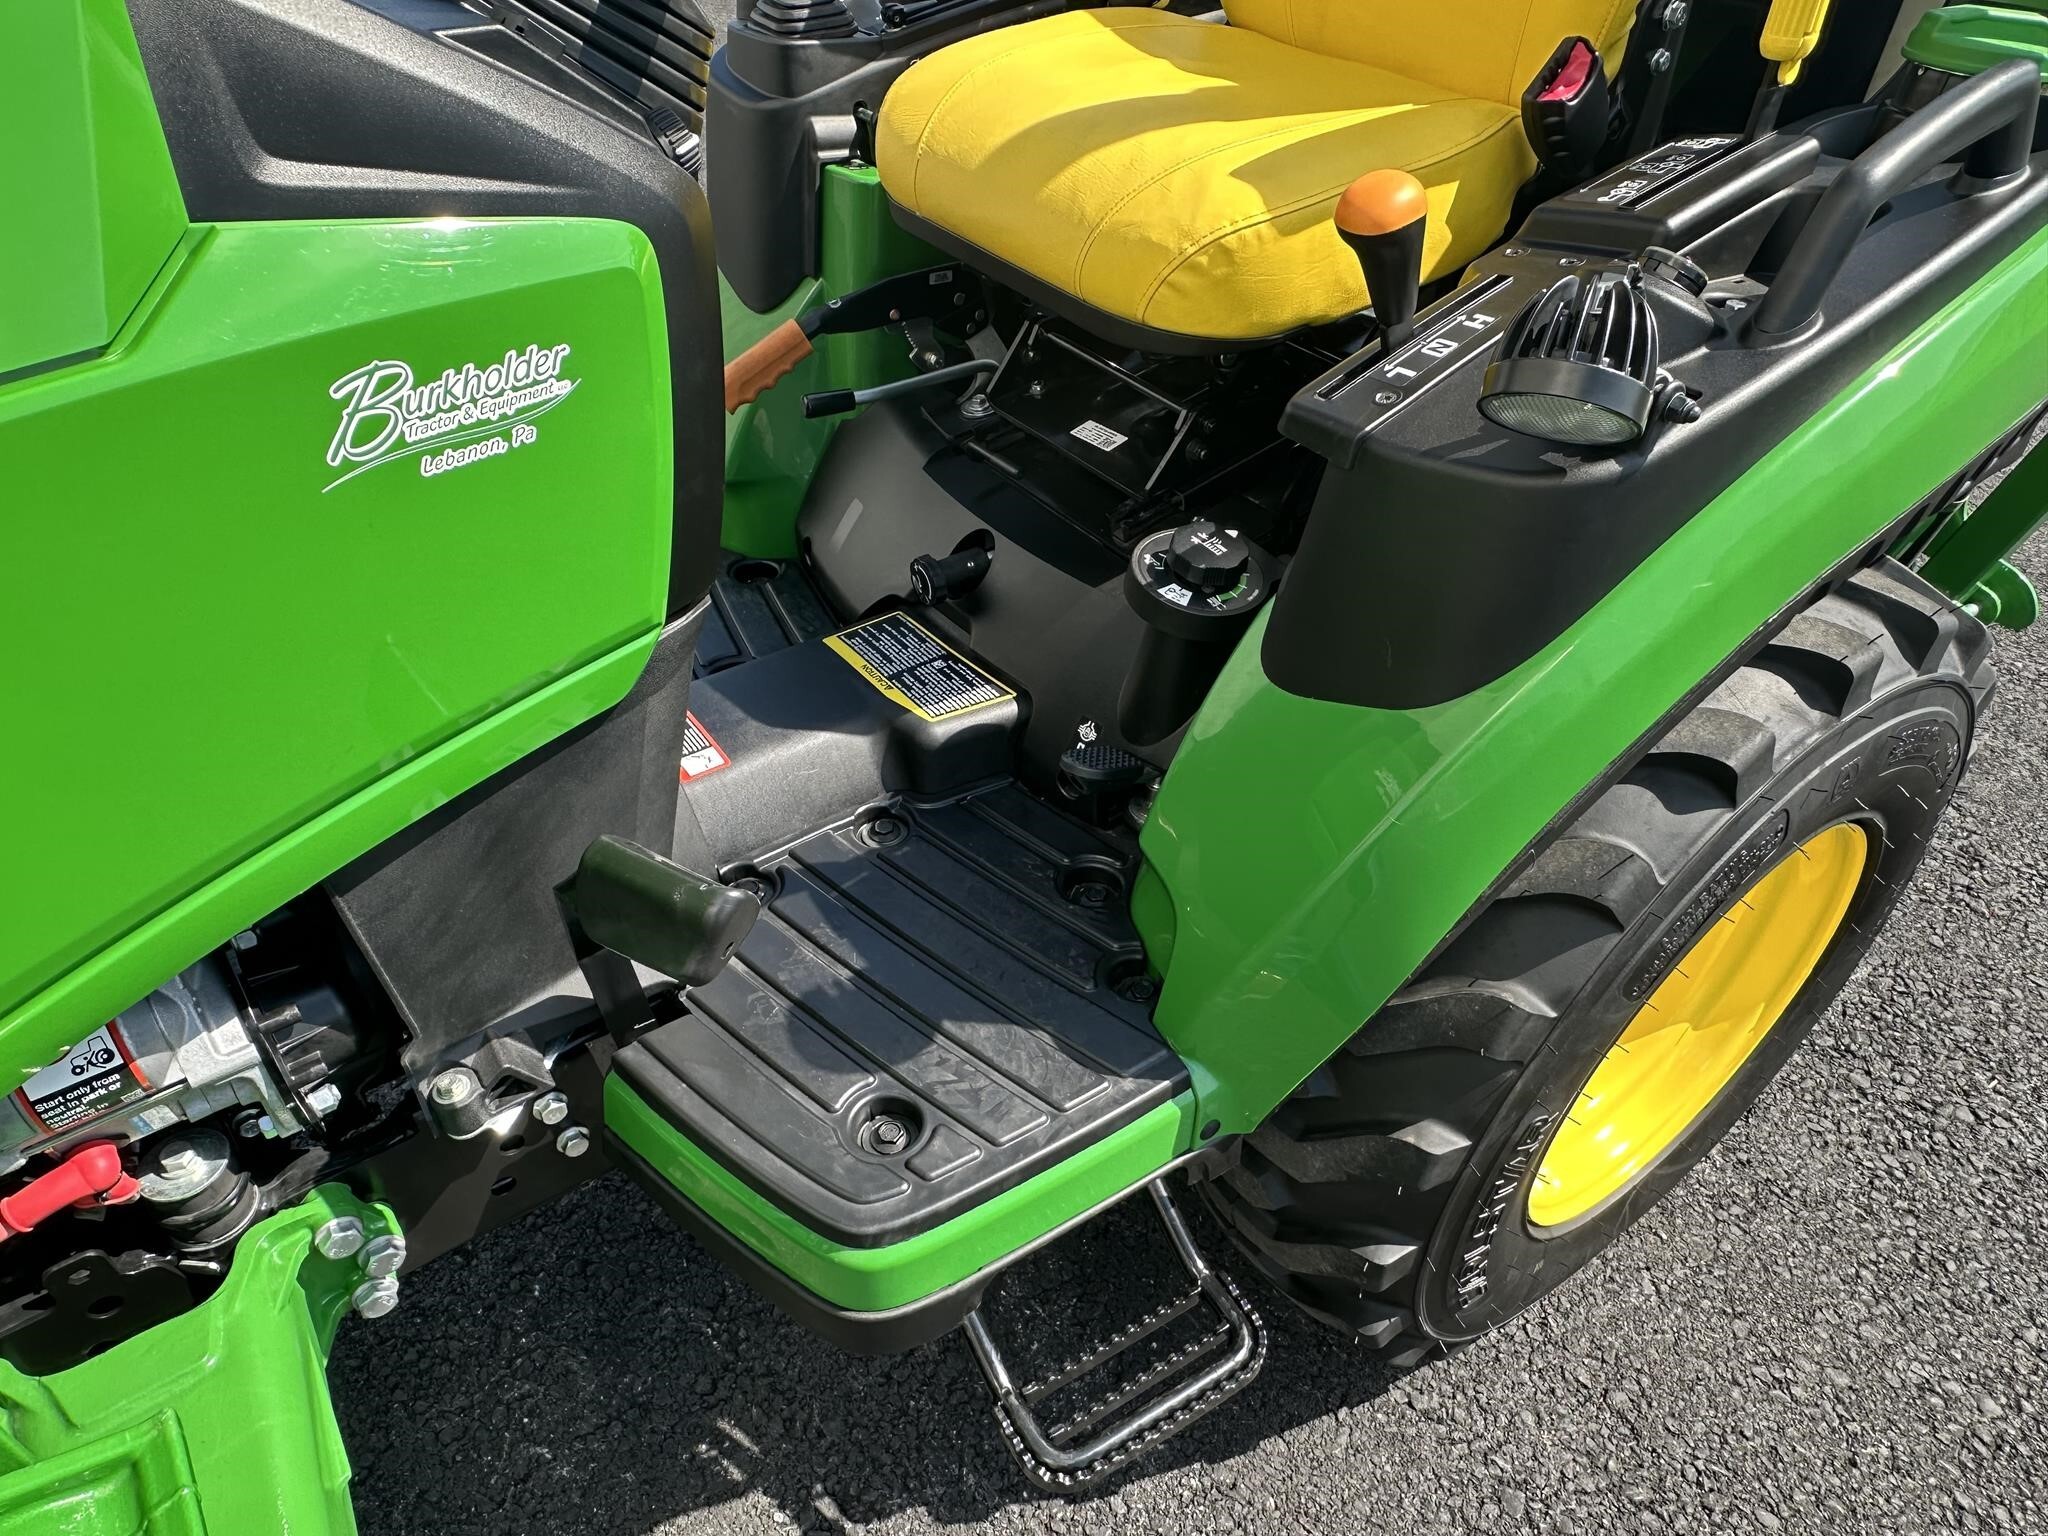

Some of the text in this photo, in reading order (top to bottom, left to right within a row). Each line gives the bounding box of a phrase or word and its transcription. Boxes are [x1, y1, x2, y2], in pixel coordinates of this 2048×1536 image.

[1463, 314, 1495, 330] H
[327, 344, 570, 466] Burkholder
[404, 411, 461, 442] Tractor
[463, 408, 475, 421] &
[480, 381, 554, 416] Equipment
[422, 426, 536, 474] Lebanon, Pa
[34, 1073, 121, 1113] Start only from
[67, 1100, 80, 1109] in
[81, 1087, 108, 1104] park
[108, 1081, 122, 1091] or
